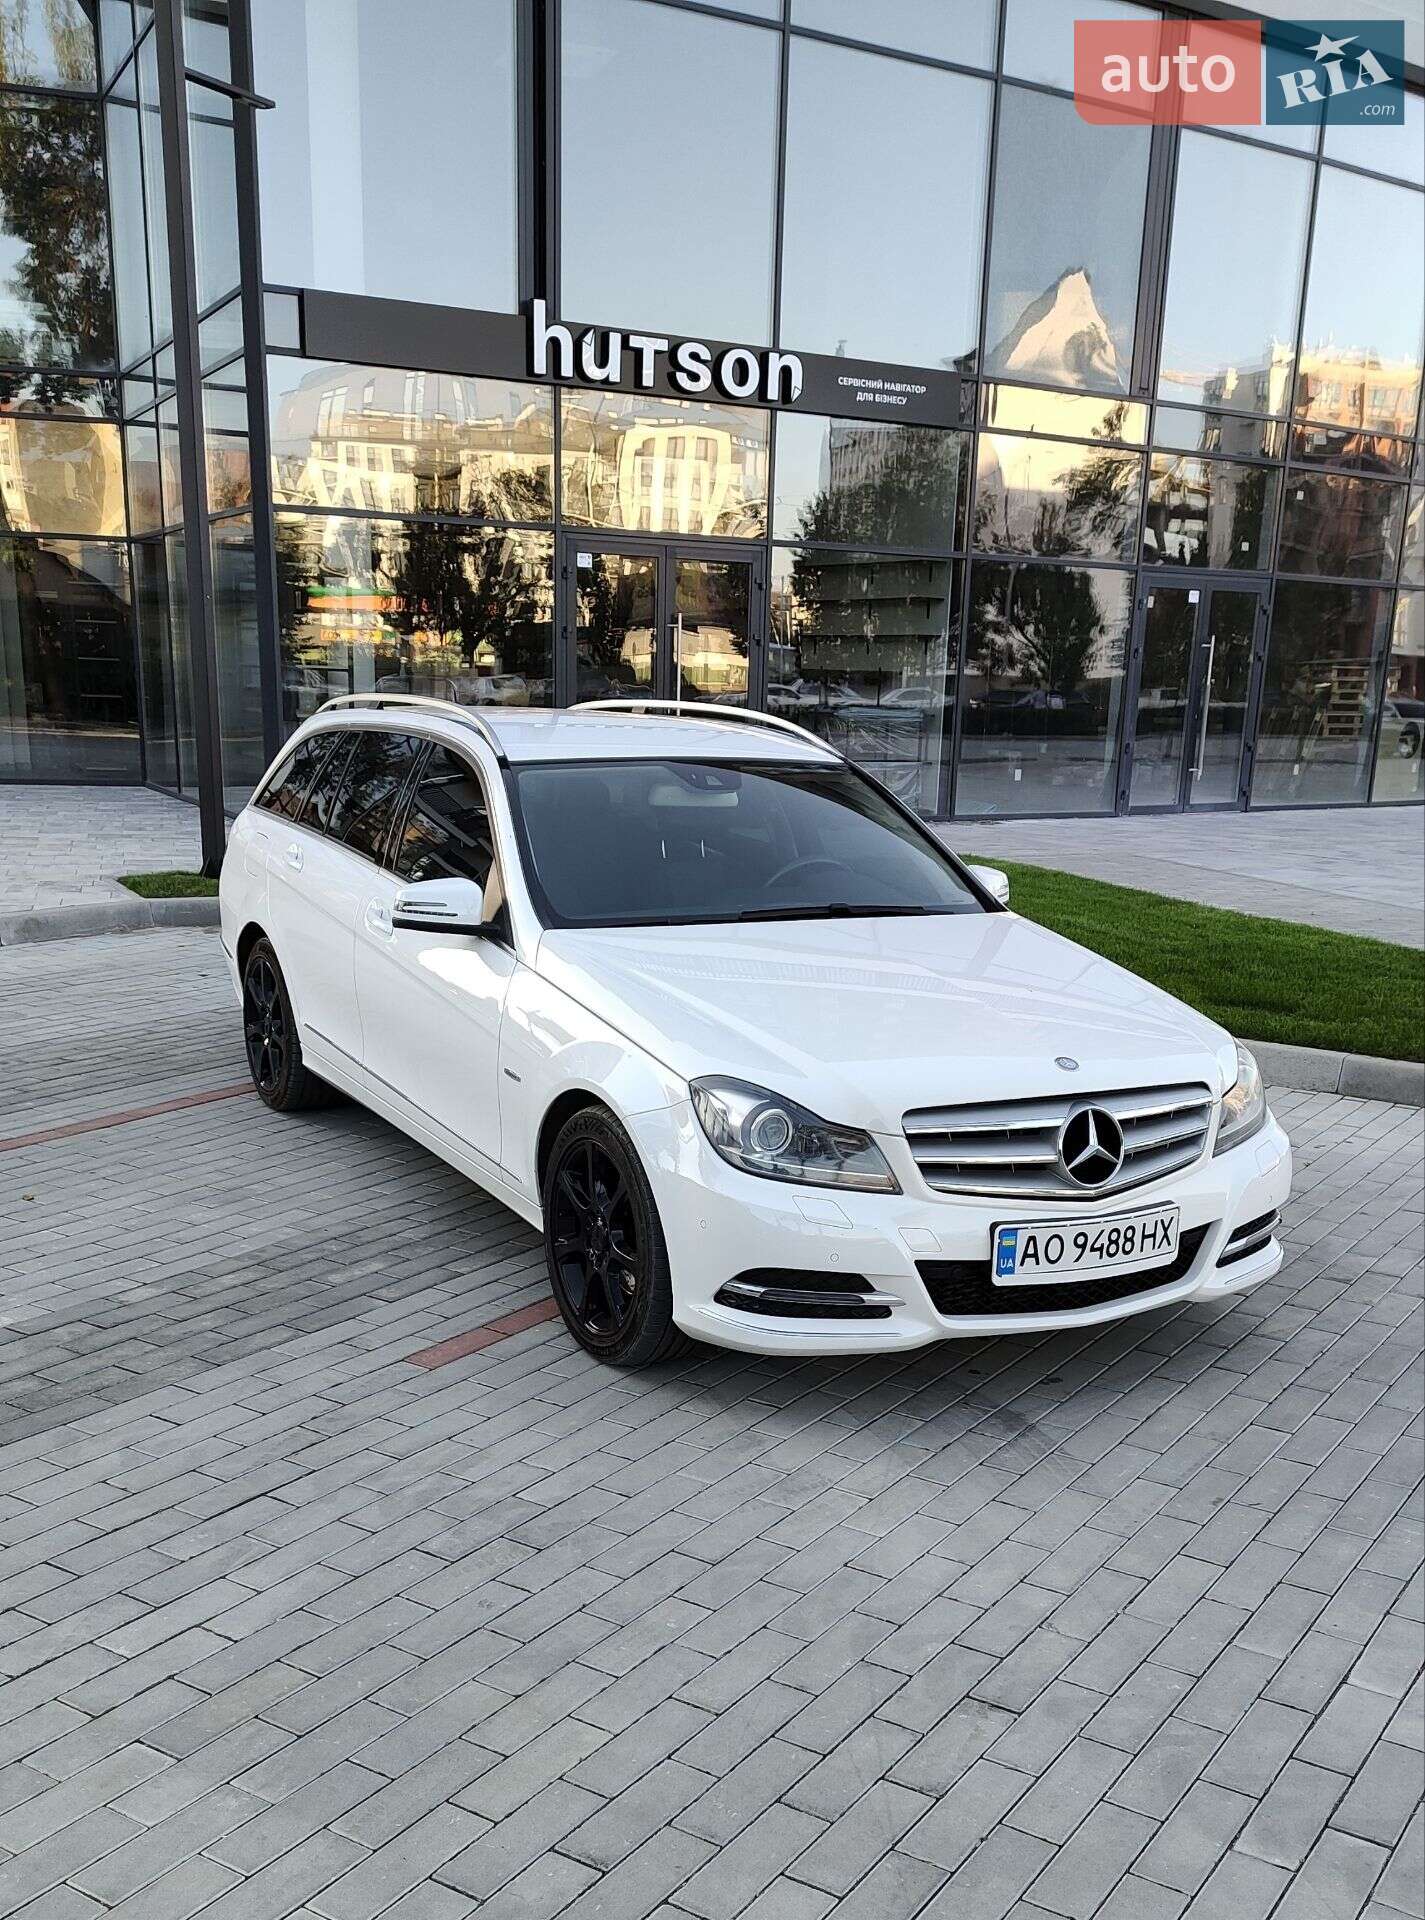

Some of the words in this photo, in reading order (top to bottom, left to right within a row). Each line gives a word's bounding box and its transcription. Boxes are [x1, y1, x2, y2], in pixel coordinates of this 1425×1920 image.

[837, 376, 883, 390] СЕРВІСНИЙ
[884, 381, 927, 394] НАВІГАТОР
[856, 391, 874, 402] ДЛЯ
[875, 393, 908, 405] БІЗНЕСУ
[1018, 1233, 1065, 1267] AO
[1073, 1225, 1136, 1263] 9488
[1000, 1258, 1014, 1269] UA
